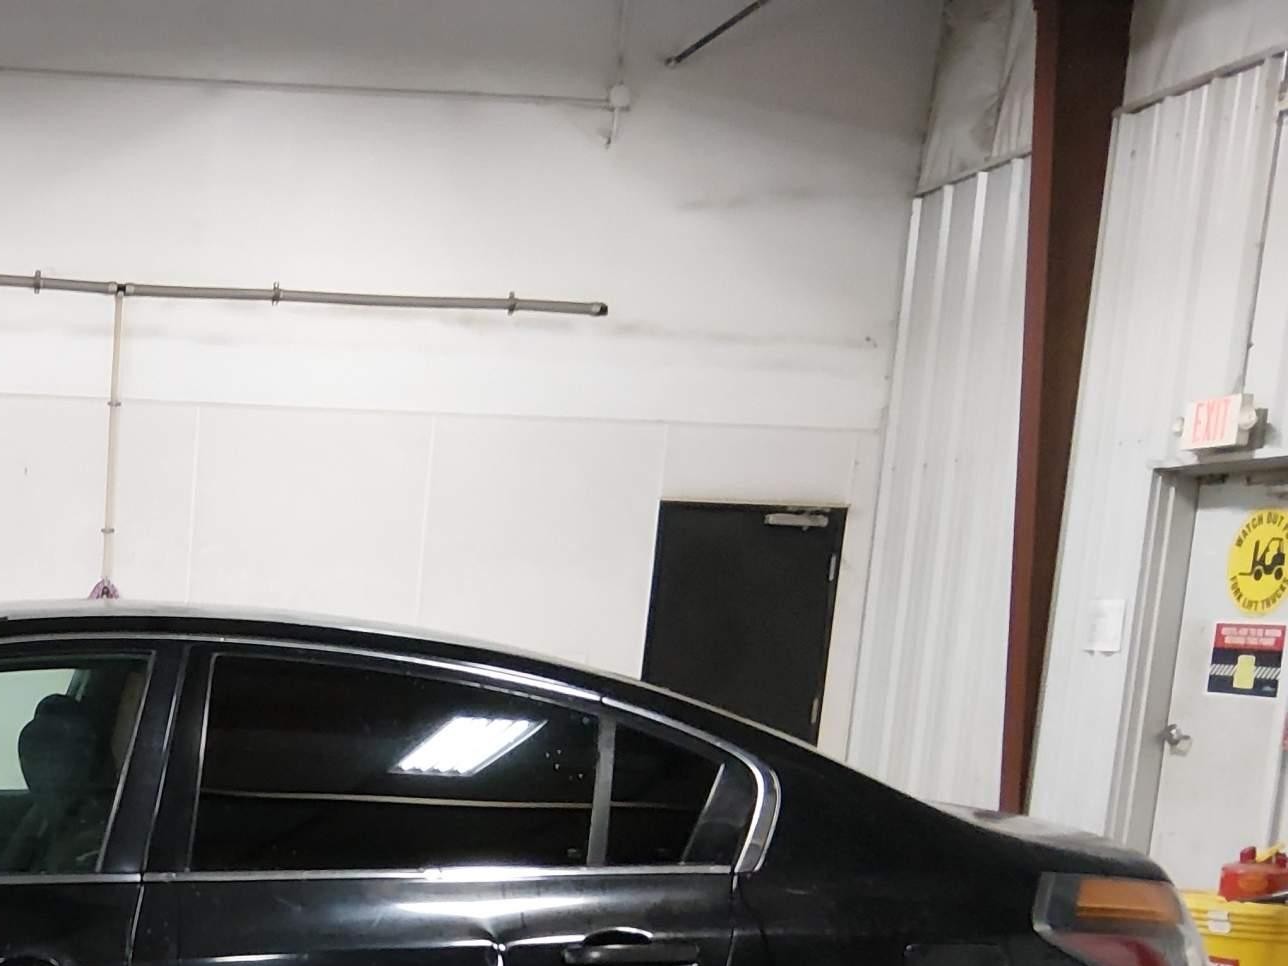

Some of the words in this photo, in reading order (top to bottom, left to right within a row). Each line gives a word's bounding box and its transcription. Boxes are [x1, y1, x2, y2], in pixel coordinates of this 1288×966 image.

[1192, 398, 1231, 443] EXIT
[1235, 514, 1263, 547] WATCH
[1266, 511, 1284, 527] OUT
[1230, 575, 1243, 602] FORK
[1242, 597, 1258, 611] LIFT
